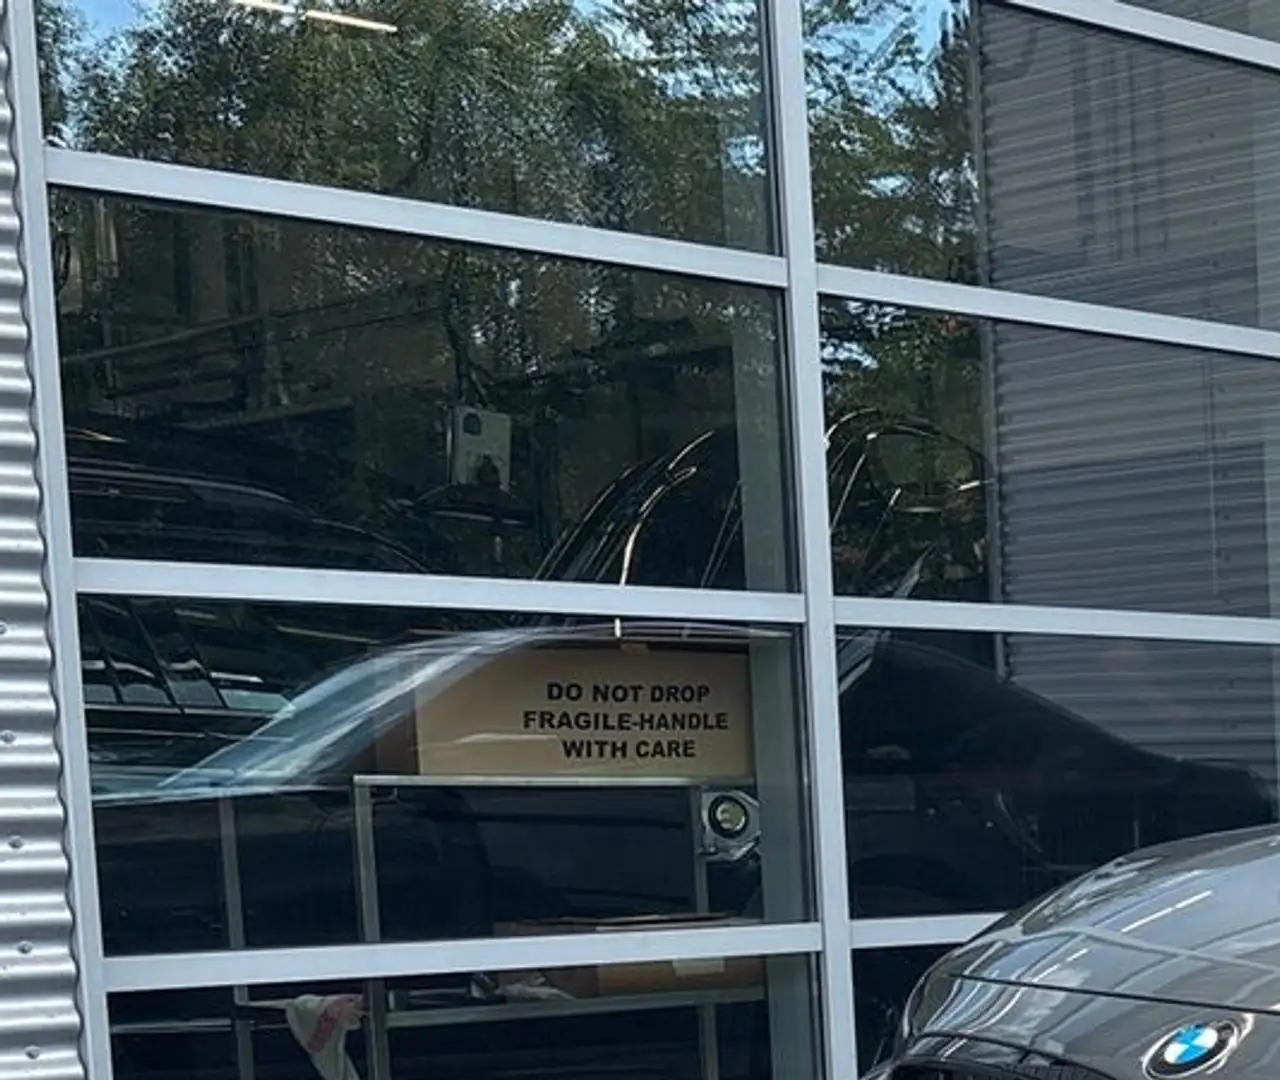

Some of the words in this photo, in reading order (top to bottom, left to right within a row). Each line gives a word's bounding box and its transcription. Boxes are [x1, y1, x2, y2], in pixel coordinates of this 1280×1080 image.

[547, 683, 583, 701] DO
[592, 684, 644, 703] NOT
[650, 685, 710, 703] DROP
[523, 710, 729, 731] FRAGILE-HANDLE
[562, 740, 627, 759] WITH
[635, 740, 696, 759] CARE
